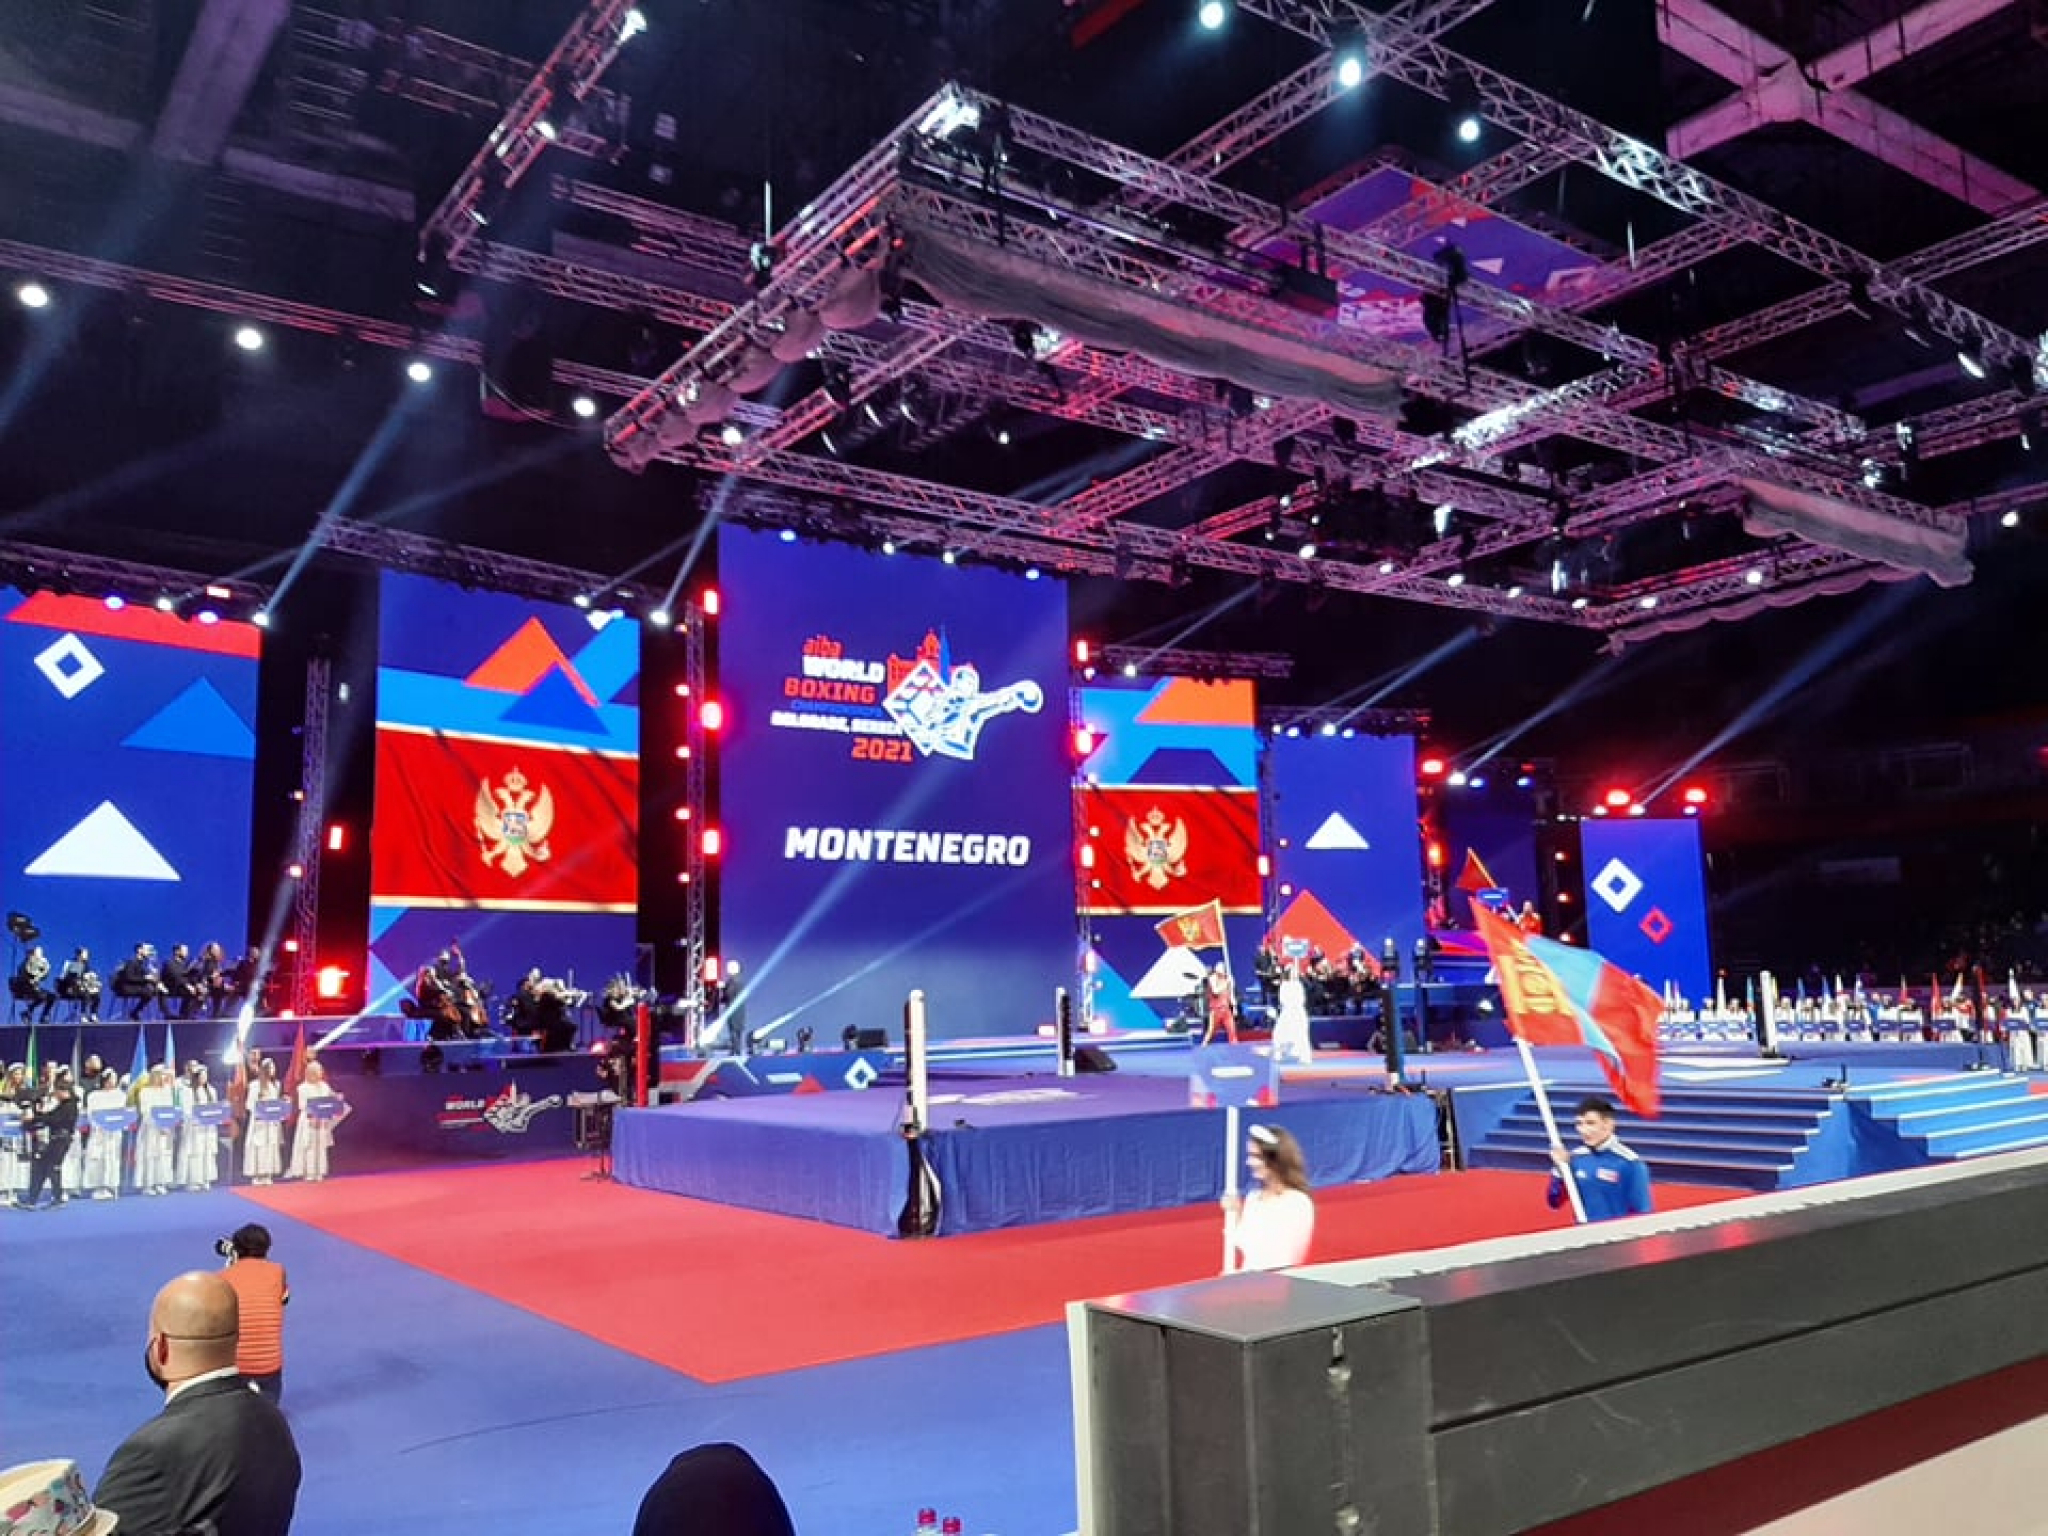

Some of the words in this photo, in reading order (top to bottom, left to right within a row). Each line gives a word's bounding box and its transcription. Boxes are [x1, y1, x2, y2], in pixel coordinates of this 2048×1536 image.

[803, 656, 885, 683] WORLD
[784, 677, 876, 704] BOXING
[852, 736, 913, 761] 2021
[784, 826, 1031, 867] MONTENEGRO
